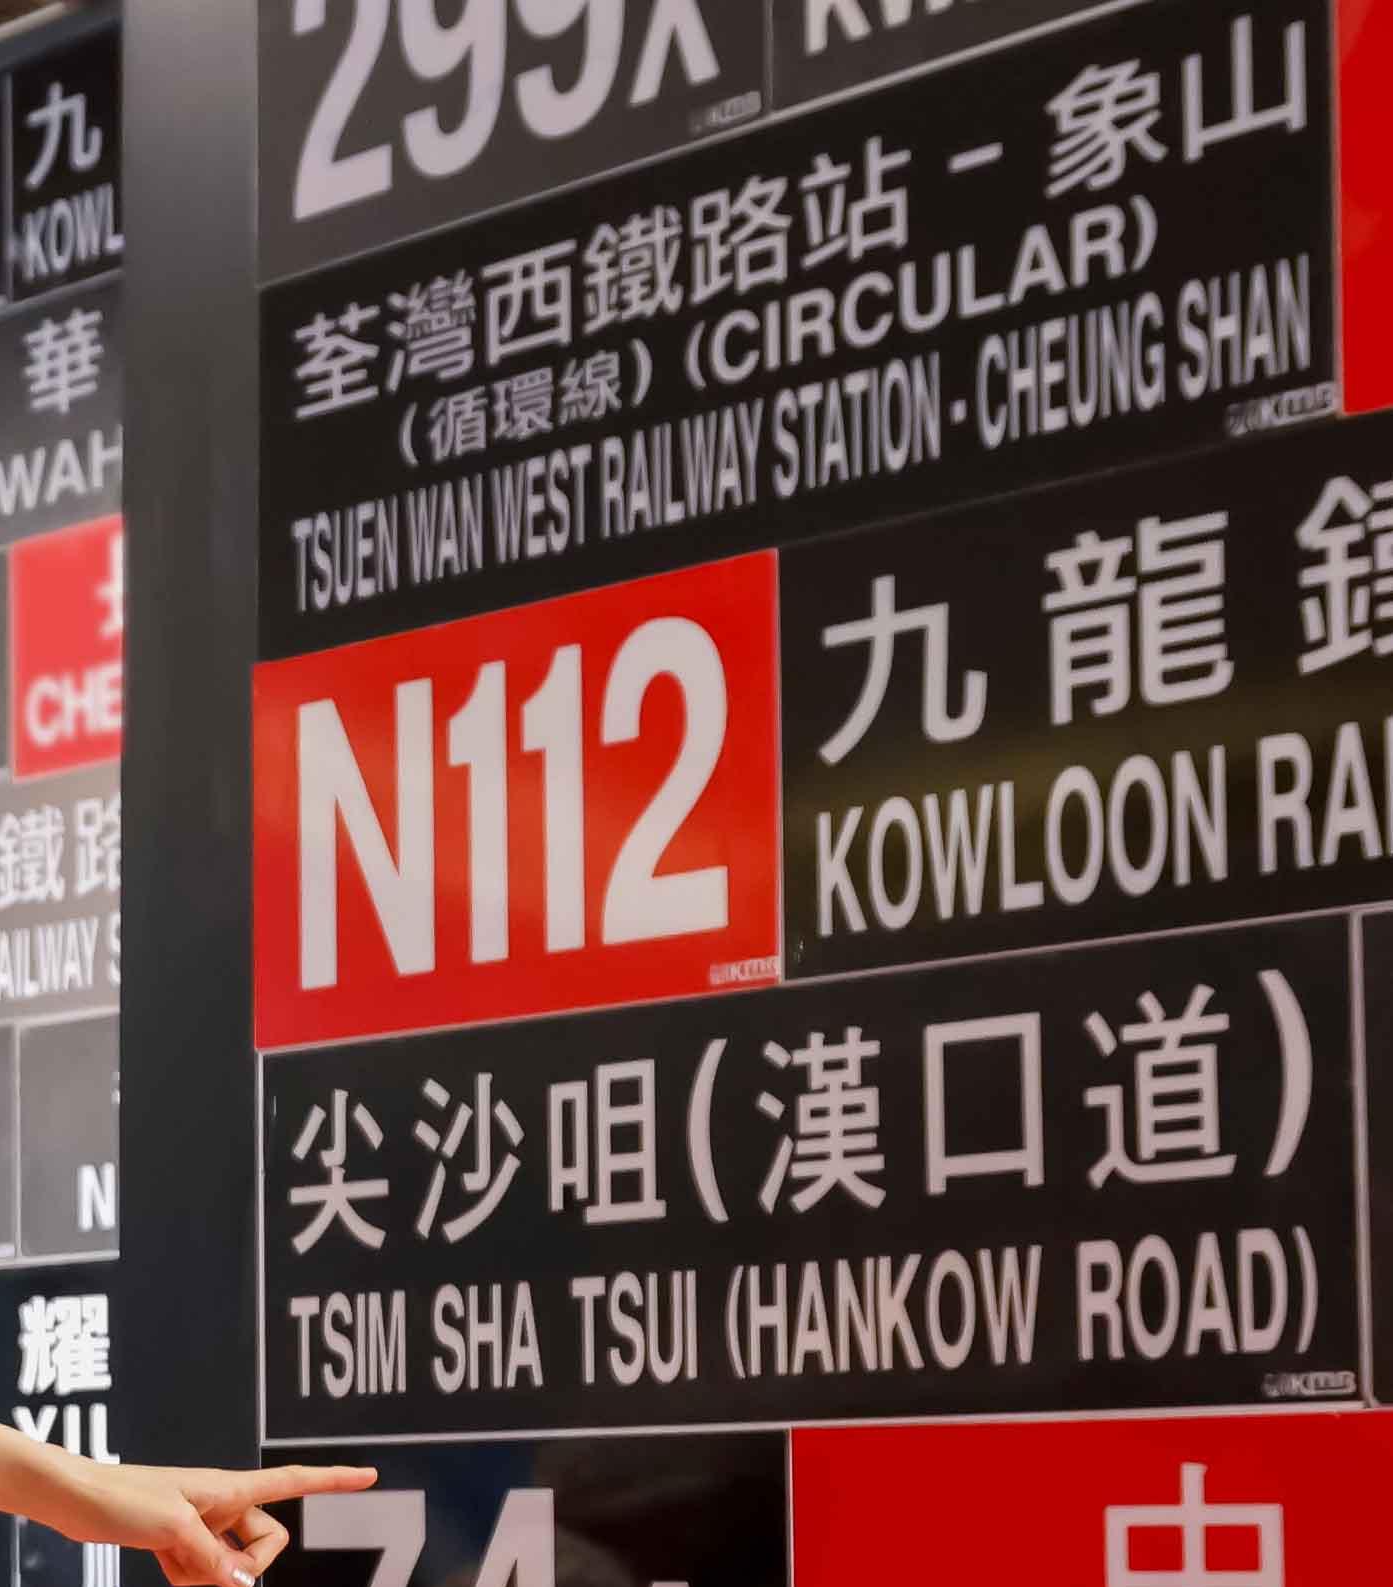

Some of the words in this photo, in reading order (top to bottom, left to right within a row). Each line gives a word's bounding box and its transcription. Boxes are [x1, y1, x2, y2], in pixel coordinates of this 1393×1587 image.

[25, 81, 103, 189] 九
[293, 136, 912, 421] 荃灣西鐵路站
[1044, 12, 1308, 198] 象山
[684, 196, 1159, 390] (CIRCULAR)
[292, 489, 400, 613] TSUEN
[410, 473, 484, 585] WAN
[491, 448, 593, 567] WEST
[601, 407, 760, 539] RAILWAY
[774, 353, 943, 500] STATION
[976, 294, 1166, 451] CHEUNG
[1176, 253, 1313, 401] SHAN
[397, 338, 654, 468] (循環線)
[295, 614, 732, 994] N112
[817, 745, 1231, 937] KOWLOON
[287, 969, 1315, 1254] 尖沙咀(漢口道)
[289, 1290, 407, 1398] TSIM
[430, 1279, 545, 1394] SHA
[570, 1268, 699, 1385] TSUI
[724, 1246, 1043, 1381] (HANKOW
[1077, 1226, 1319, 1363] ROAD)
